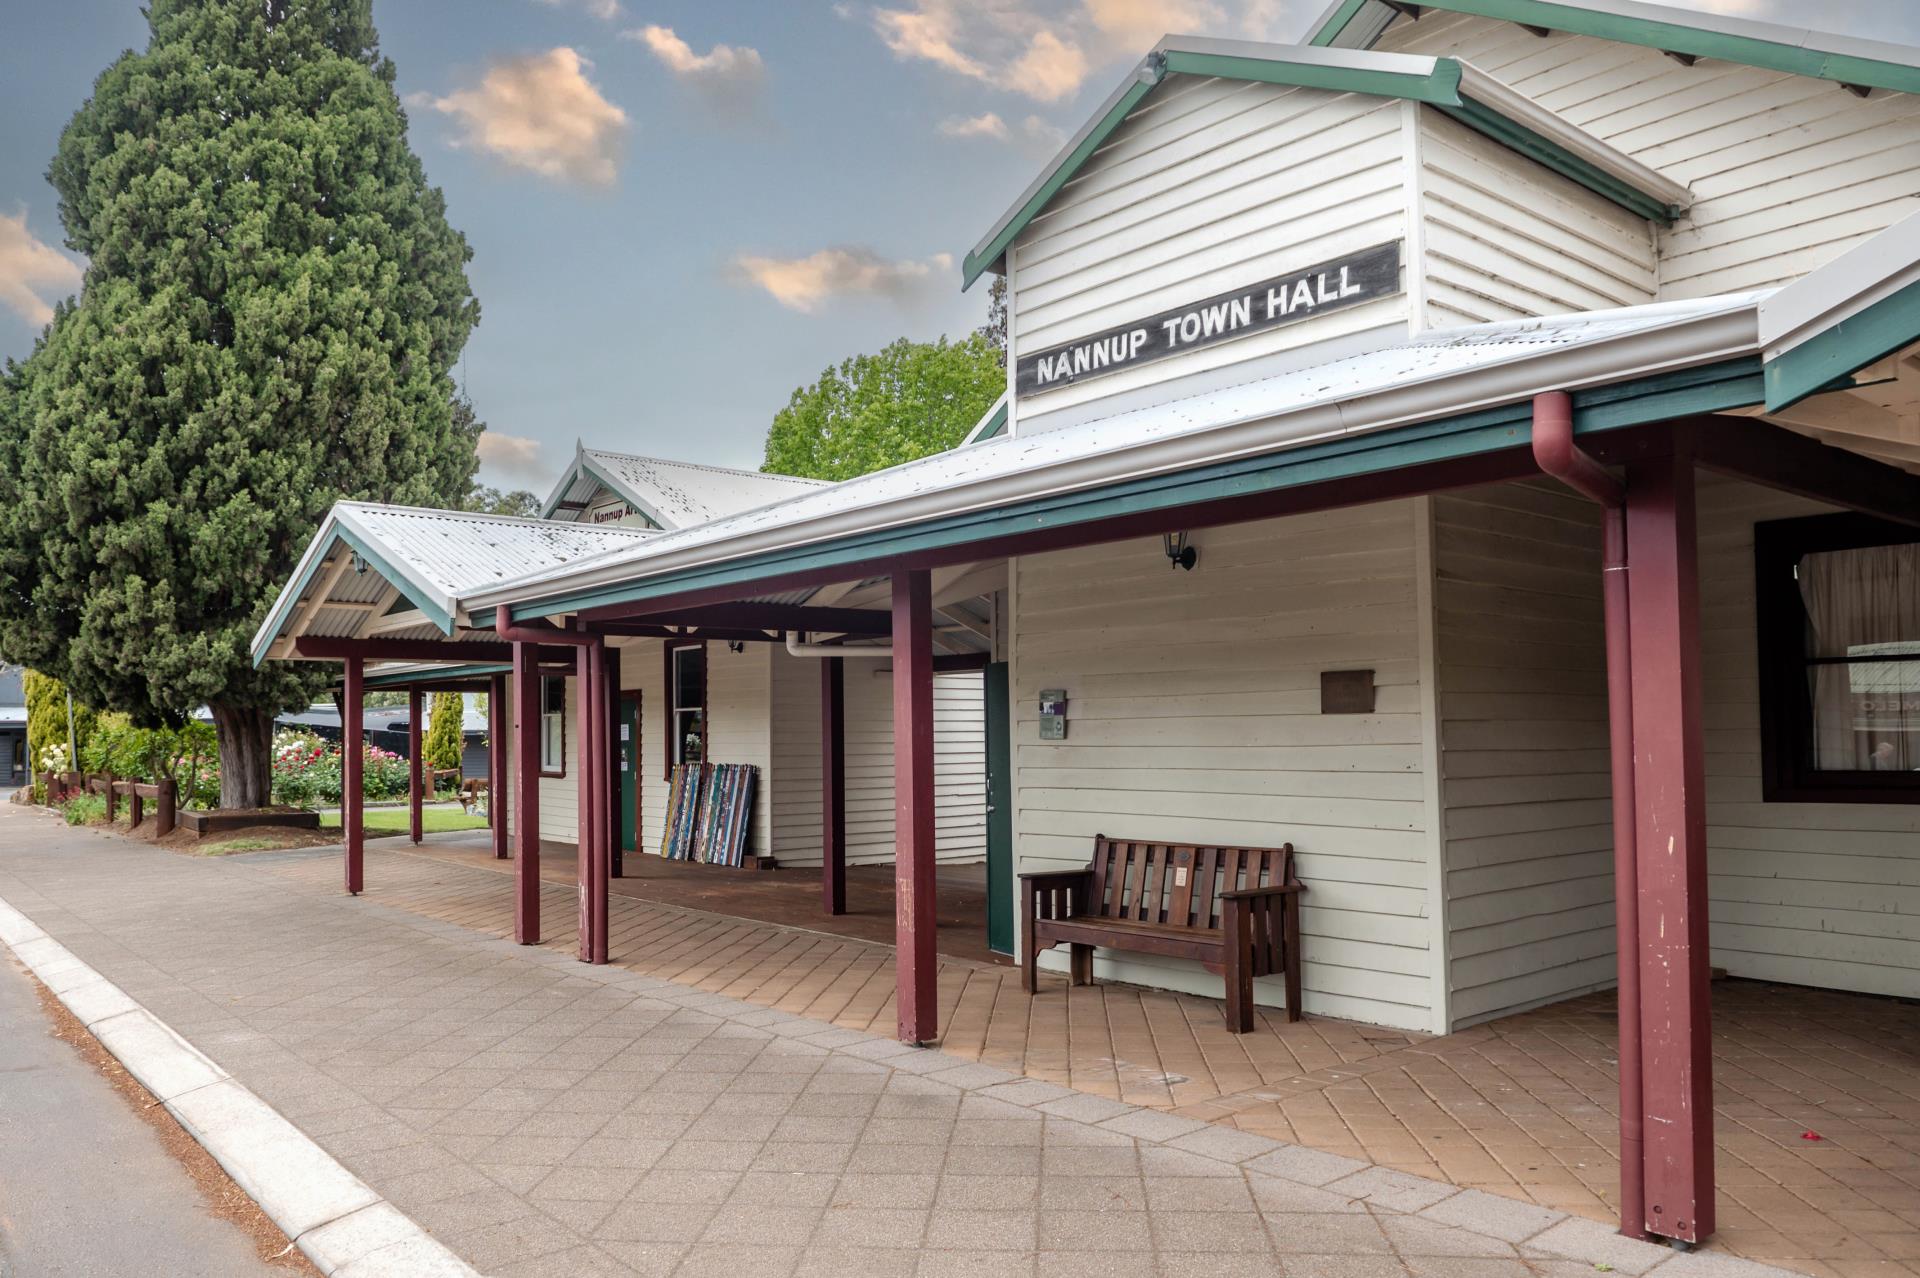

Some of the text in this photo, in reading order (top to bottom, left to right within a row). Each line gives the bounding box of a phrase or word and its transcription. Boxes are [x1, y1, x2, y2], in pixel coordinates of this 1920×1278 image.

[1037, 265, 1361, 385] NANNUP TOWN HALL
[594, 508, 623, 524] Nannup
